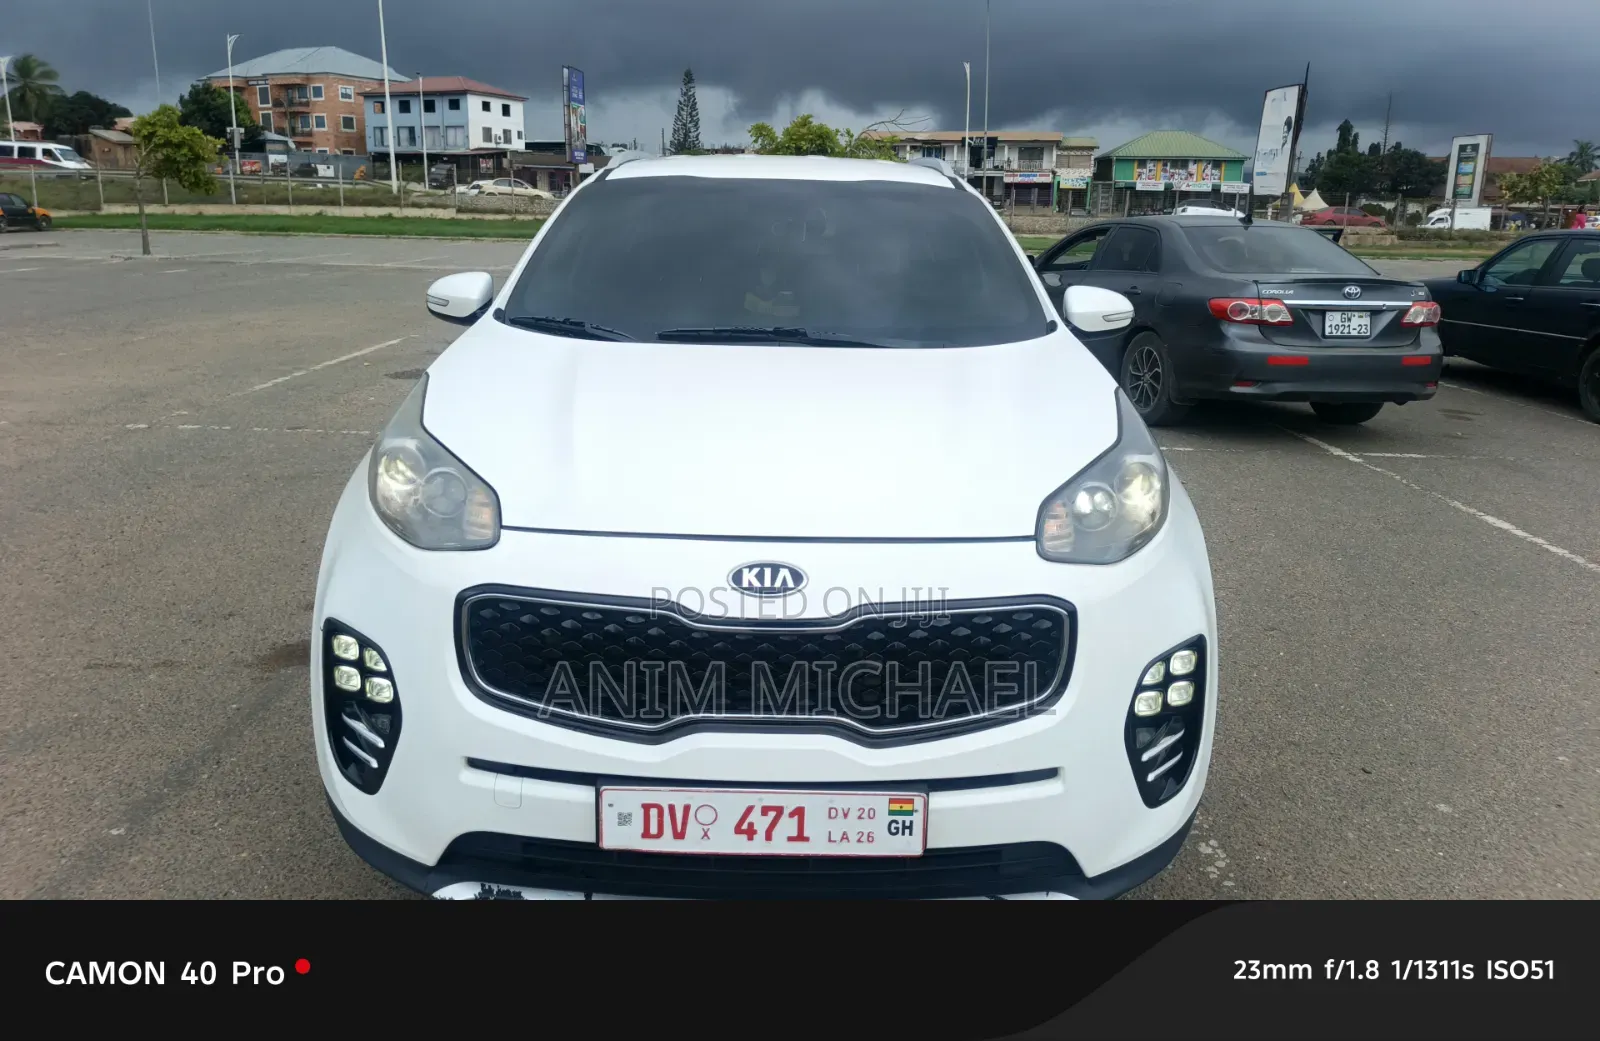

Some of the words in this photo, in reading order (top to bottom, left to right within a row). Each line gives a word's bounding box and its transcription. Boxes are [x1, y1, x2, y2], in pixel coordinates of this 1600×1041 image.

[1340, 312, 1352, 323] GW
[1327, 323, 1369, 335] 1921-23
[742, 567, 795, 588] KIA
[827, 807, 850, 820] DV
[857, 807, 876, 820] 20
[641, 802, 691, 840] DV
[733, 804, 810, 843] 471
[887, 819, 914, 837] GH
[827, 830, 850, 843] LA
[856, 830, 875, 843] 26
